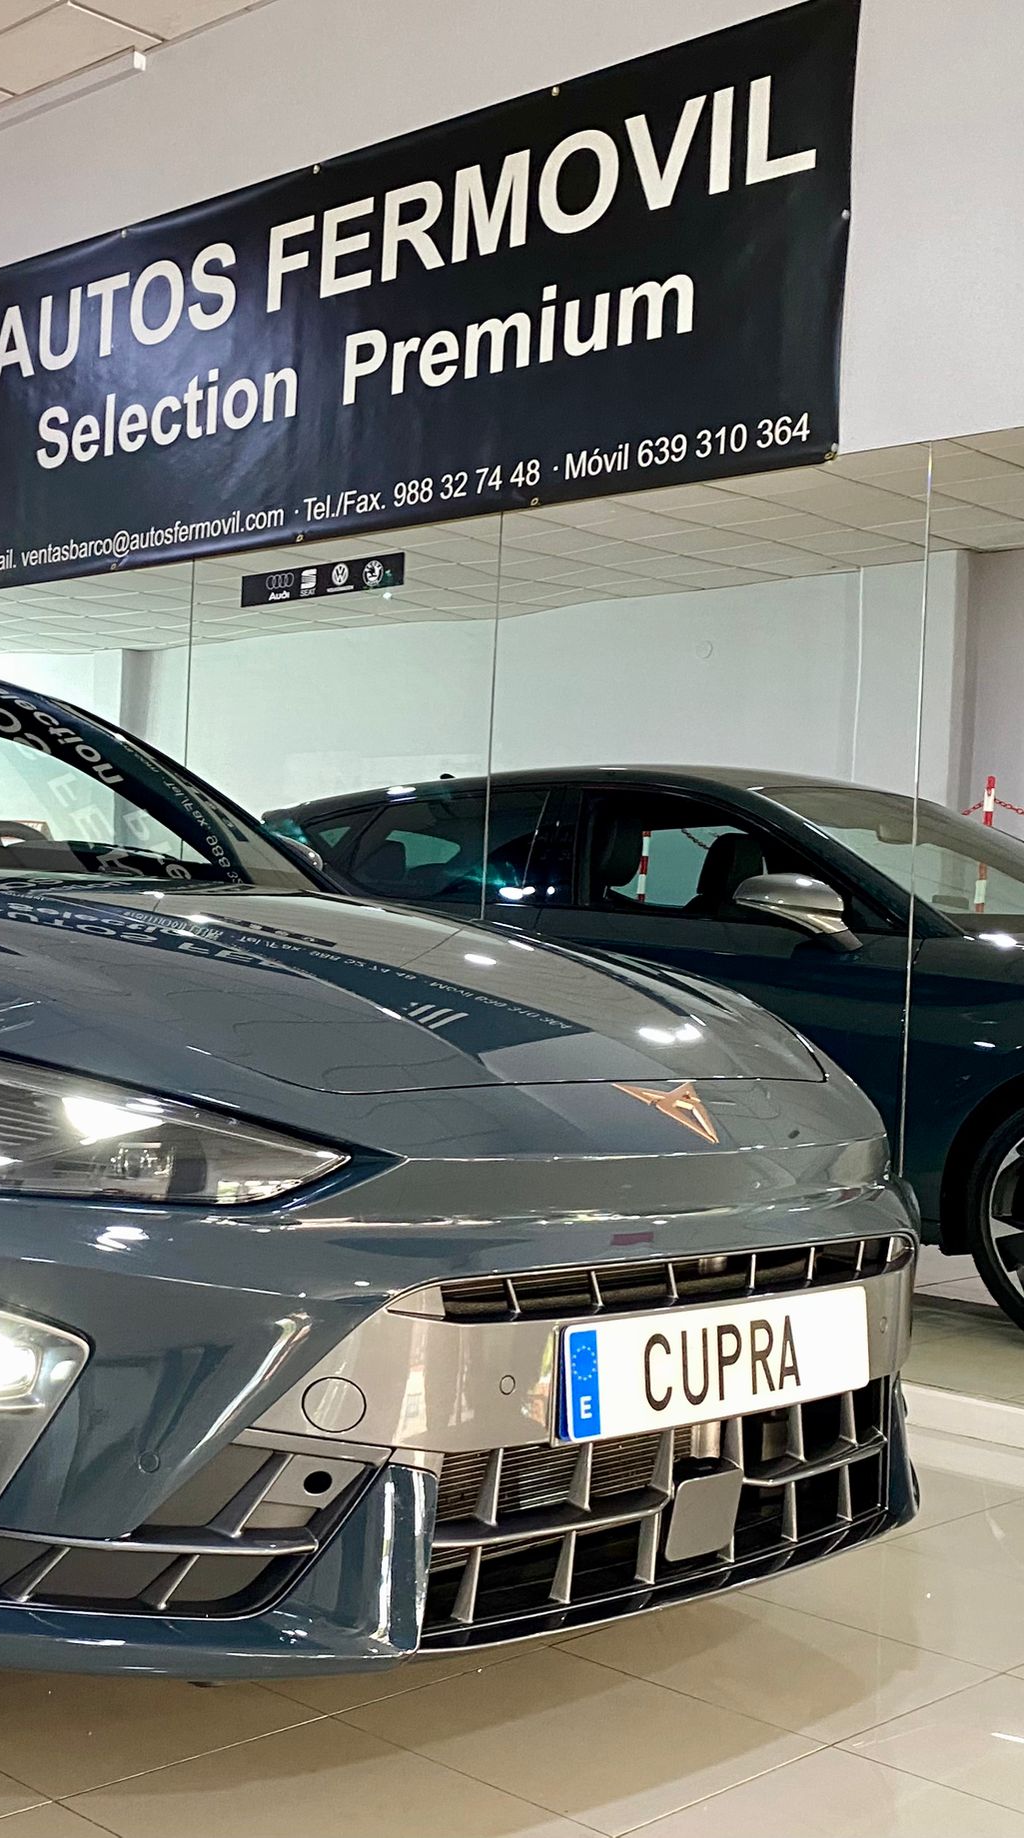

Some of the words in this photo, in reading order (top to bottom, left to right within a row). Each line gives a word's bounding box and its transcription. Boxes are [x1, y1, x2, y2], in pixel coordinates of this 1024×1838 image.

[266, 75, 818, 315] FERMOVIL
[36, 367, 299, 470] Selection
[342, 273, 695, 407] Premium
[21, 507, 285, 568] ventasbarco@autosfermovil.com
[303, 489, 386, 523] Tel./Fax.
[393, 477, 434, 509] 988
[439, 471, 468, 501] 32
[475, 465, 503, 495] 74
[509, 459, 541, 488] 48
[564, 442, 631, 481] Móvil
[637, 433, 688, 468] 639
[695, 423, 749, 458] 310
[756, 412, 811, 449] 364
[268, 591, 291, 602] Audi
[300, 588, 317, 597] SEAT
[579, 1395, 593, 1420] E
[643, 1314, 802, 1413] CUPRA
